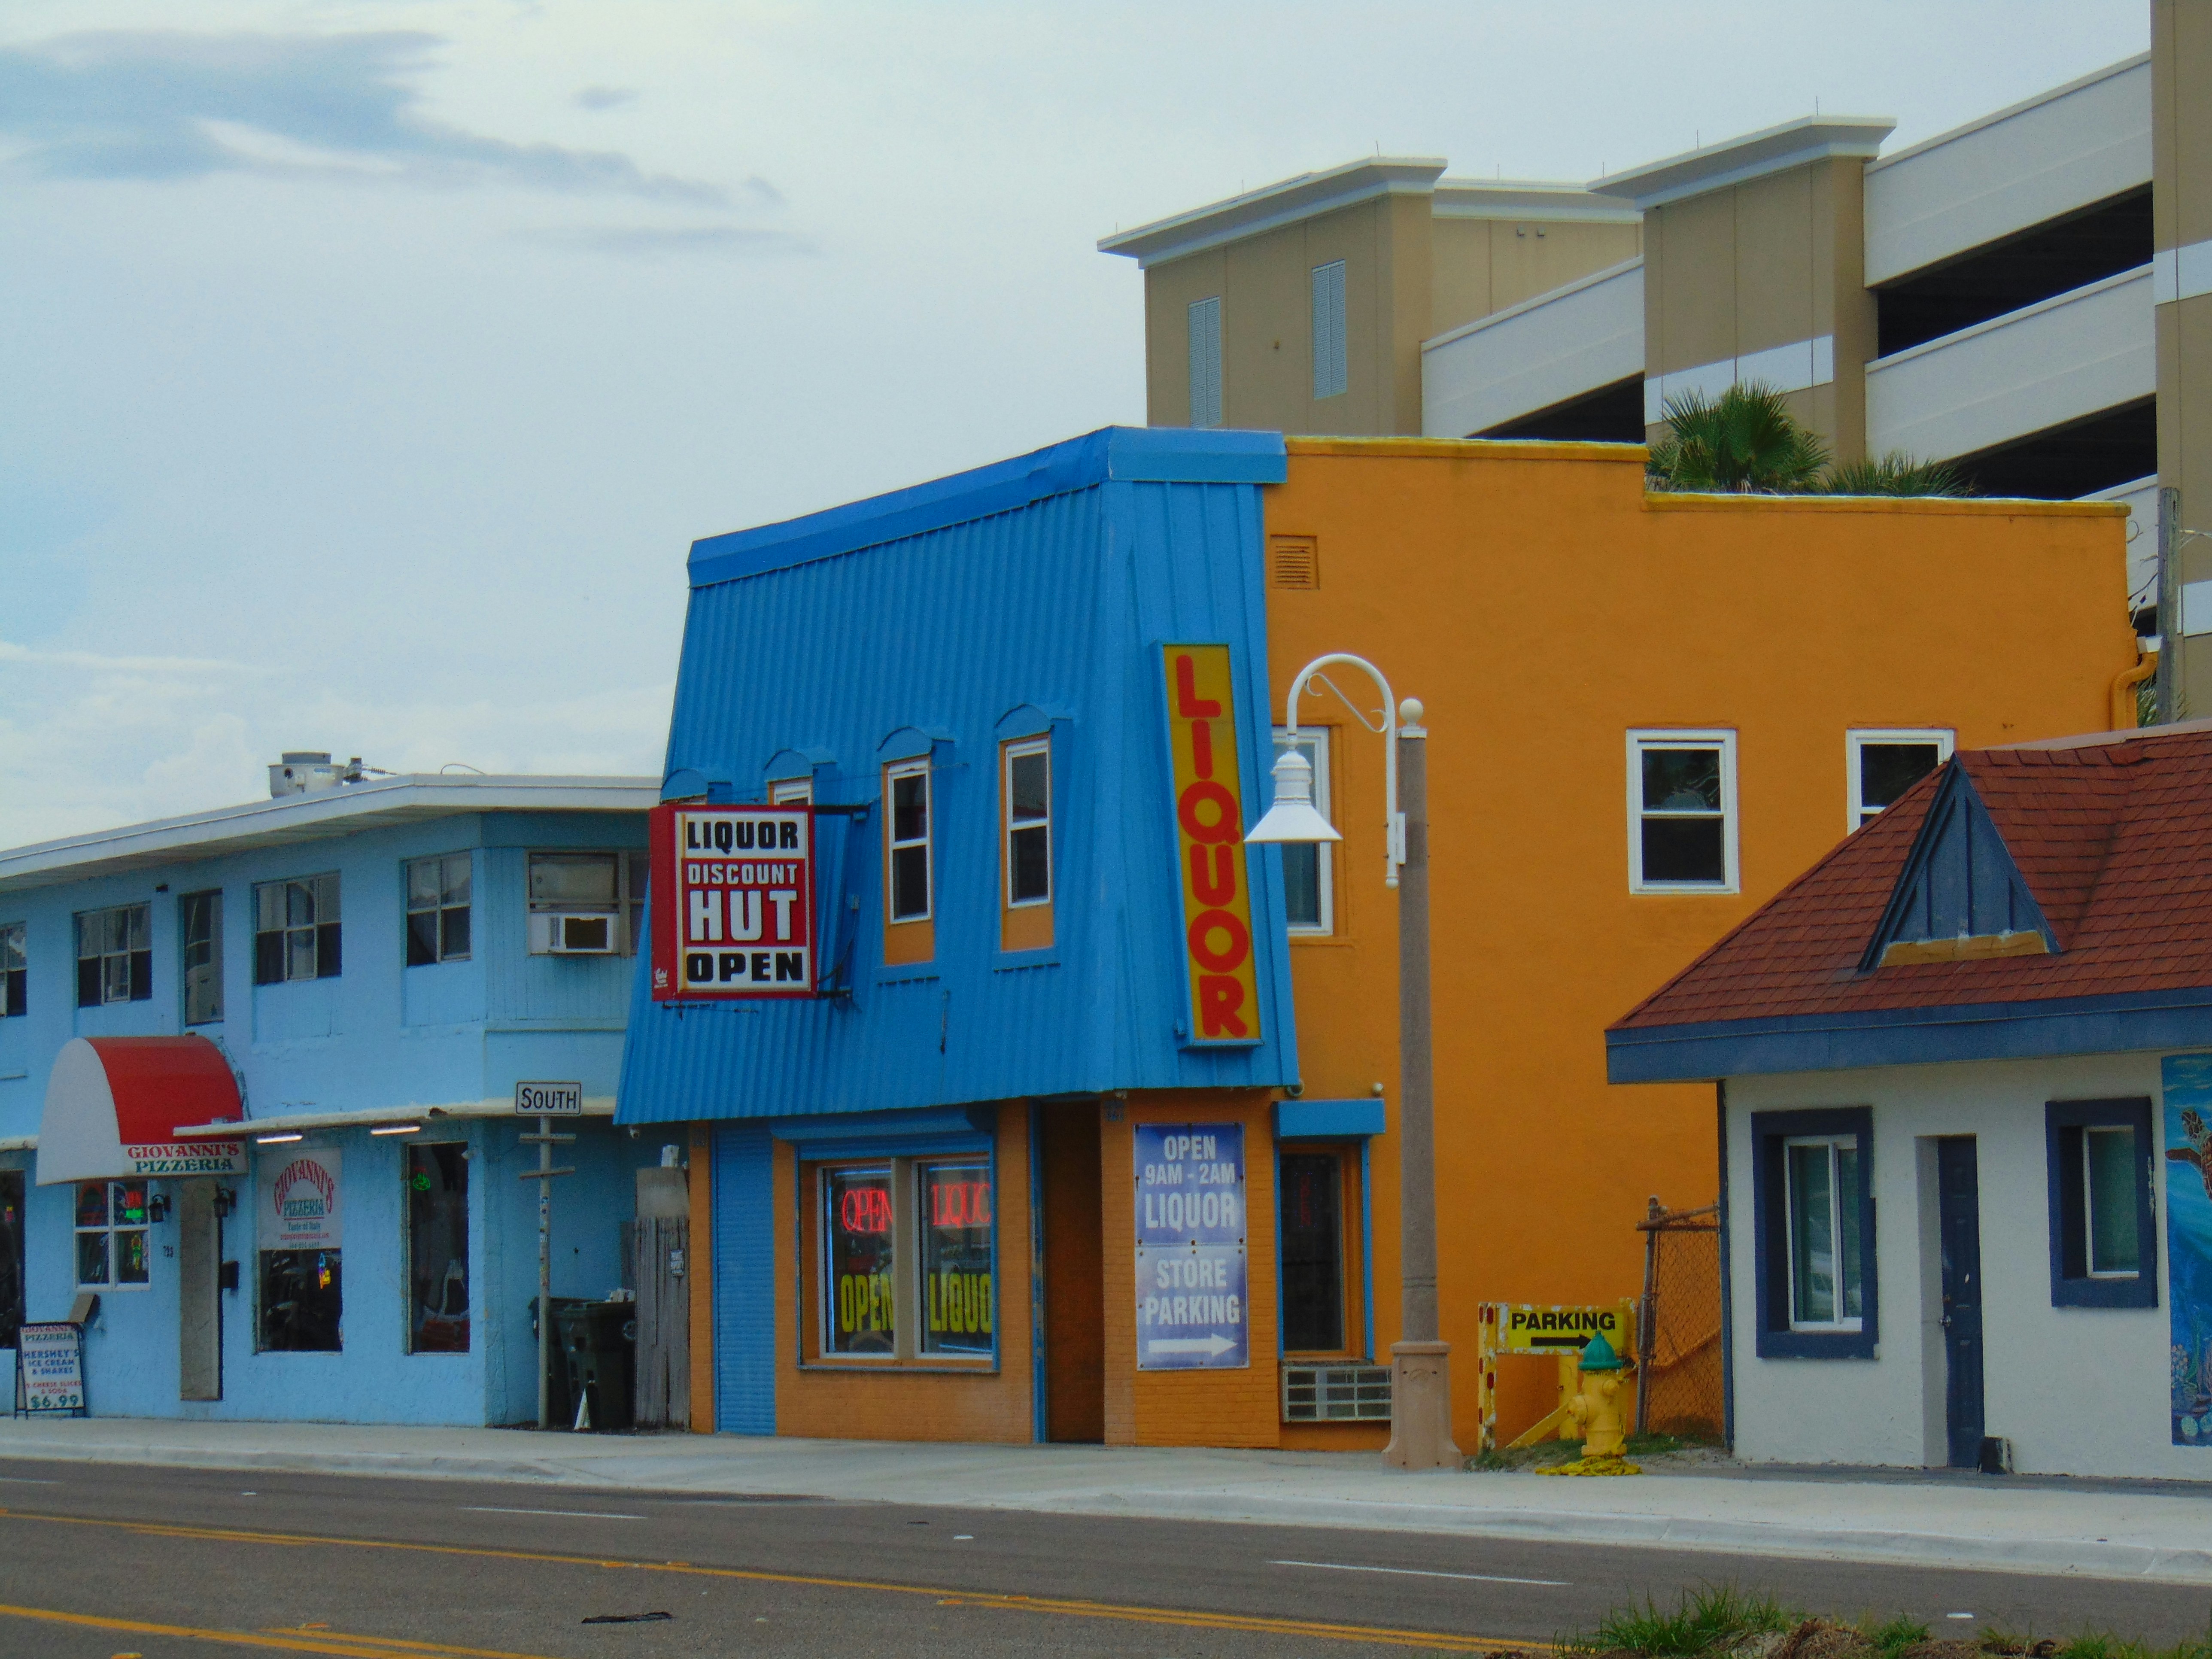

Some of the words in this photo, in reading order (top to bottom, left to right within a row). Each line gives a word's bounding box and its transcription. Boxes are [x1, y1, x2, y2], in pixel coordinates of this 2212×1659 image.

[687, 821, 799, 854] LIQUOR
[1176, 655, 1249, 1038] LIQUOR
[688, 863, 798, 884] DISCOUNT
[689, 890, 798, 941] HUT
[687, 952, 803, 982] OPEN
[521, 1087, 577, 1109] SOUTH
[128, 1144, 240, 1158] GIOVANNI'S
[1164, 1135, 1216, 1160] OPEN
[135, 1159, 234, 1173] PIZZERIA
[1145, 1163, 1182, 1185] 9AM
[1199, 1162, 1236, 1185] 2AM
[274, 1159, 334, 1215] GIOVANNI'S
[284, 1199, 324, 1217] PIZZERIA
[1145, 1192, 1237, 1232] LIQUOR
[1156, 1258, 1227, 1288] STORE
[1145, 1294, 1240, 1325] PARKING
[1511, 1312, 1616, 1331] PARKING
[25, 1333, 74, 1341] PIZZERIA
[41, 1367, 73, 1375] SHAKES
[30, 1395, 79, 1409] $6.99
